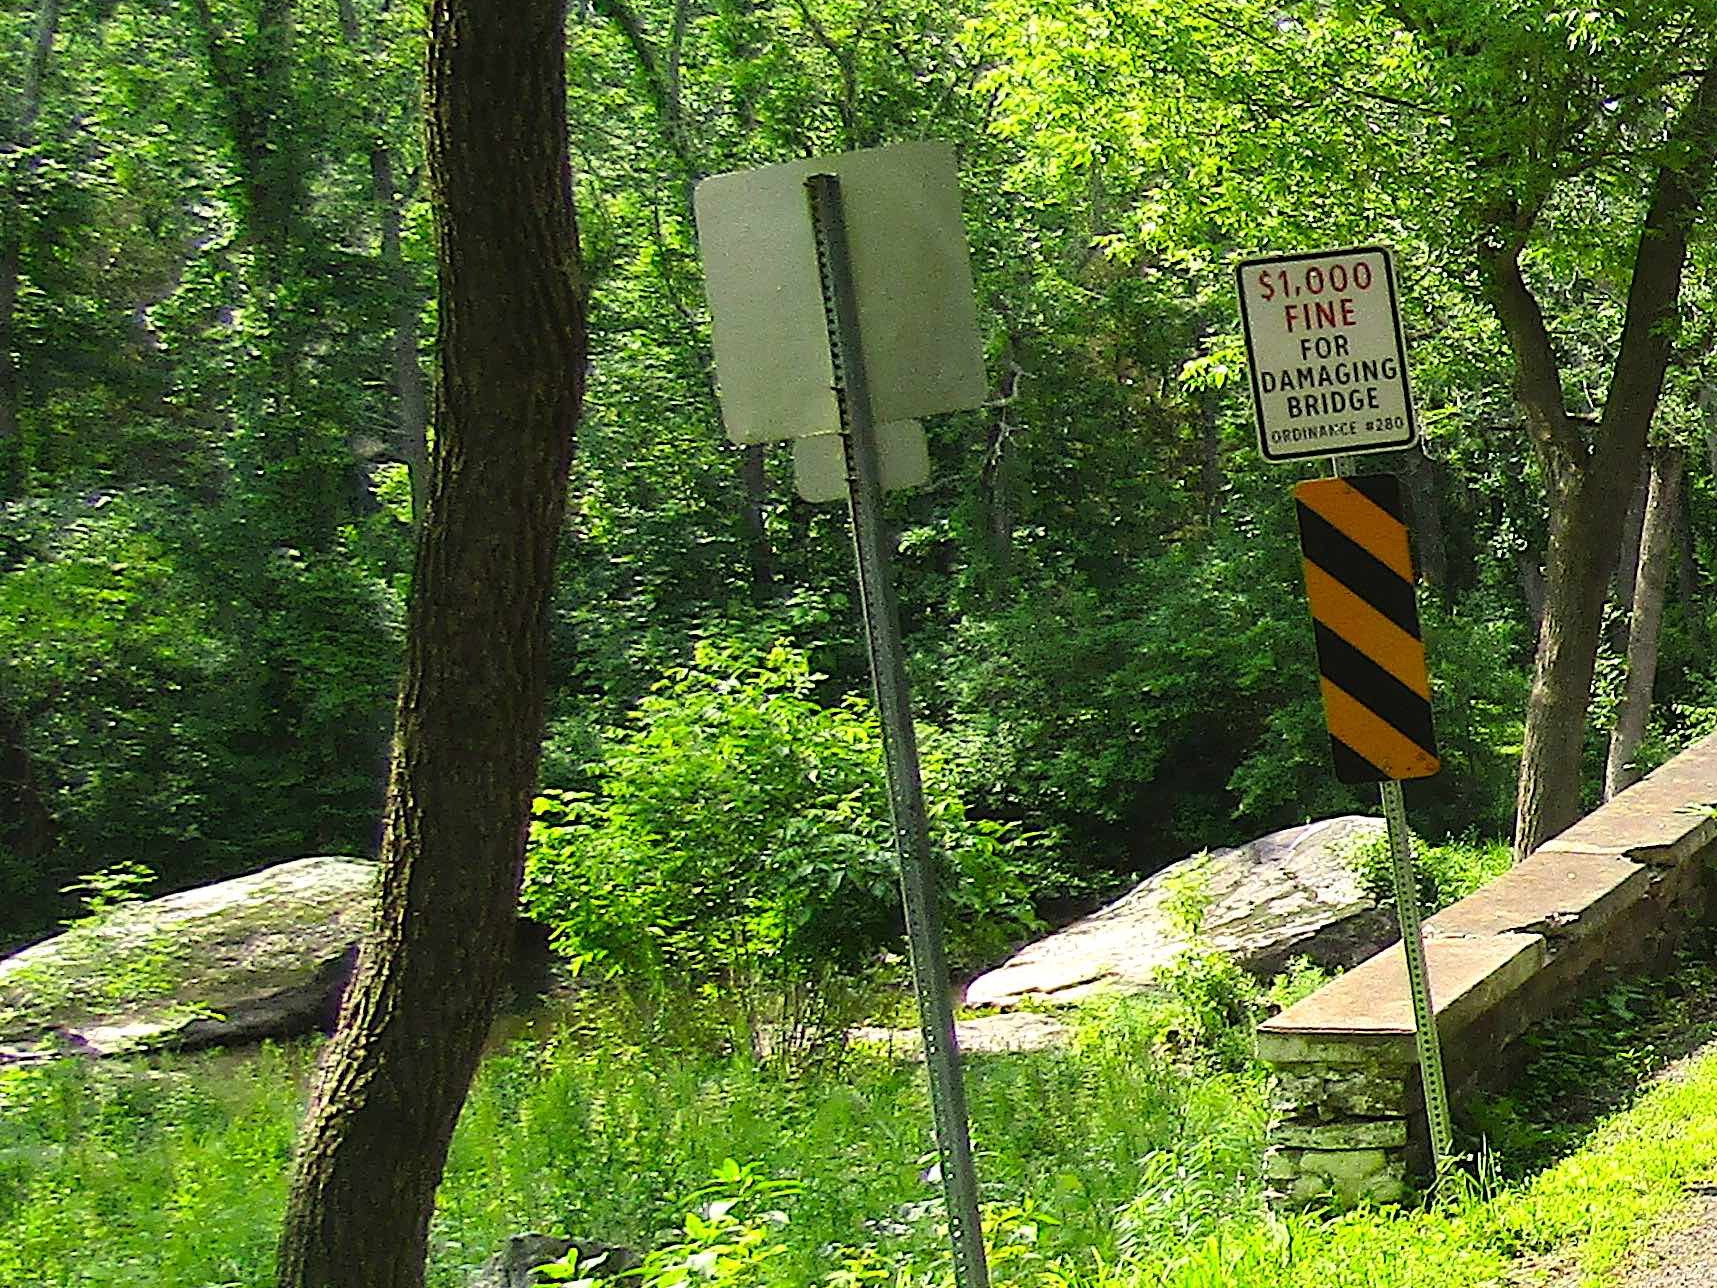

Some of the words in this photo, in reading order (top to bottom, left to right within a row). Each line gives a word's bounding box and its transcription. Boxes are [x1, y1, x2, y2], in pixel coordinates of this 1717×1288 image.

[1258, 261, 1372, 302] $1,000
[1284, 298, 1357, 333] FINE
[1300, 334, 1350, 361] FOR
[1260, 357, 1398, 394] DAMAGING
[1286, 387, 1380, 419] BRIDGE
[1271, 420, 1357, 444] ORDINANCE
[1366, 416, 1404, 433] #280
